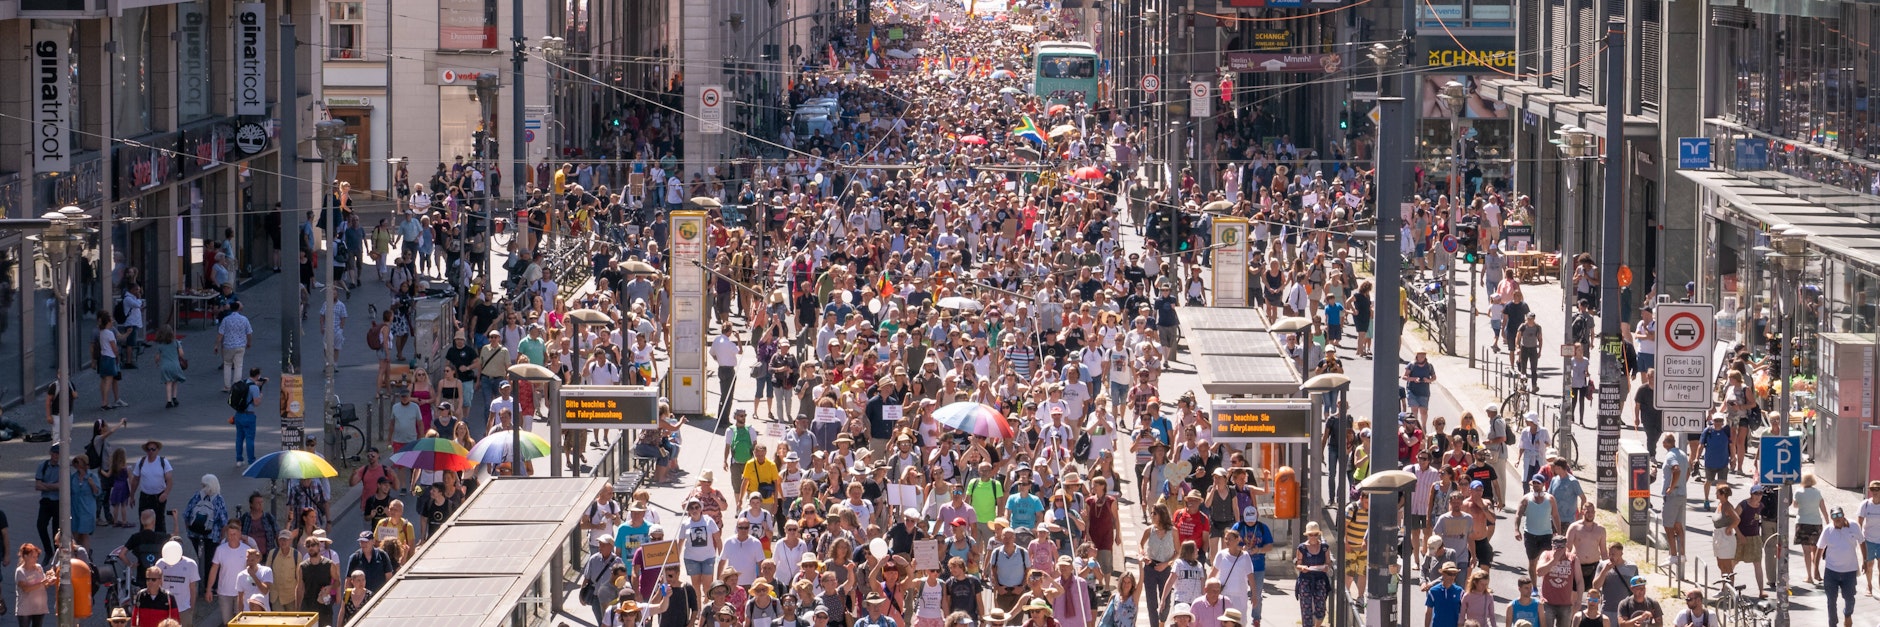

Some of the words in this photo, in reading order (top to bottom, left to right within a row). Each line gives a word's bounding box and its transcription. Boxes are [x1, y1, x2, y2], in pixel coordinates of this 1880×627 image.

[240, 12, 261, 107] ginatricot
[1284, 55, 1311, 63] Mmmh!
[1145, 79, 1157, 88] 30
[37, 40, 64, 161] ginatricot
[1682, 156, 1708, 165] randstad
[1226, 231, 1235, 243] H
[1666, 358, 1689, 366] Diesel
[1691, 358, 1703, 366] bis
[1667, 367, 1685, 375] Euro
[1687, 367, 1701, 375] 5/V
[1667, 384, 1700, 393] Anlieger
[565, 400, 580, 408] Bitte
[581, 400, 606, 408] beachten
[607, 400, 617, 408] Sie
[565, 410, 576, 418] den
[577, 411, 623, 420] Fahrplanaushang
[1217, 413, 1232, 422] Bitte
[1233, 413, 1259, 422] beachten
[1260, 413, 1270, 422] Sie
[1667, 416, 1686, 427] 100
[1689, 418, 1700, 427] m
[1217, 424, 1228, 432] den
[1229, 424, 1276, 434] Fahrplanaushang
[1777, 448, 1792, 473] P
